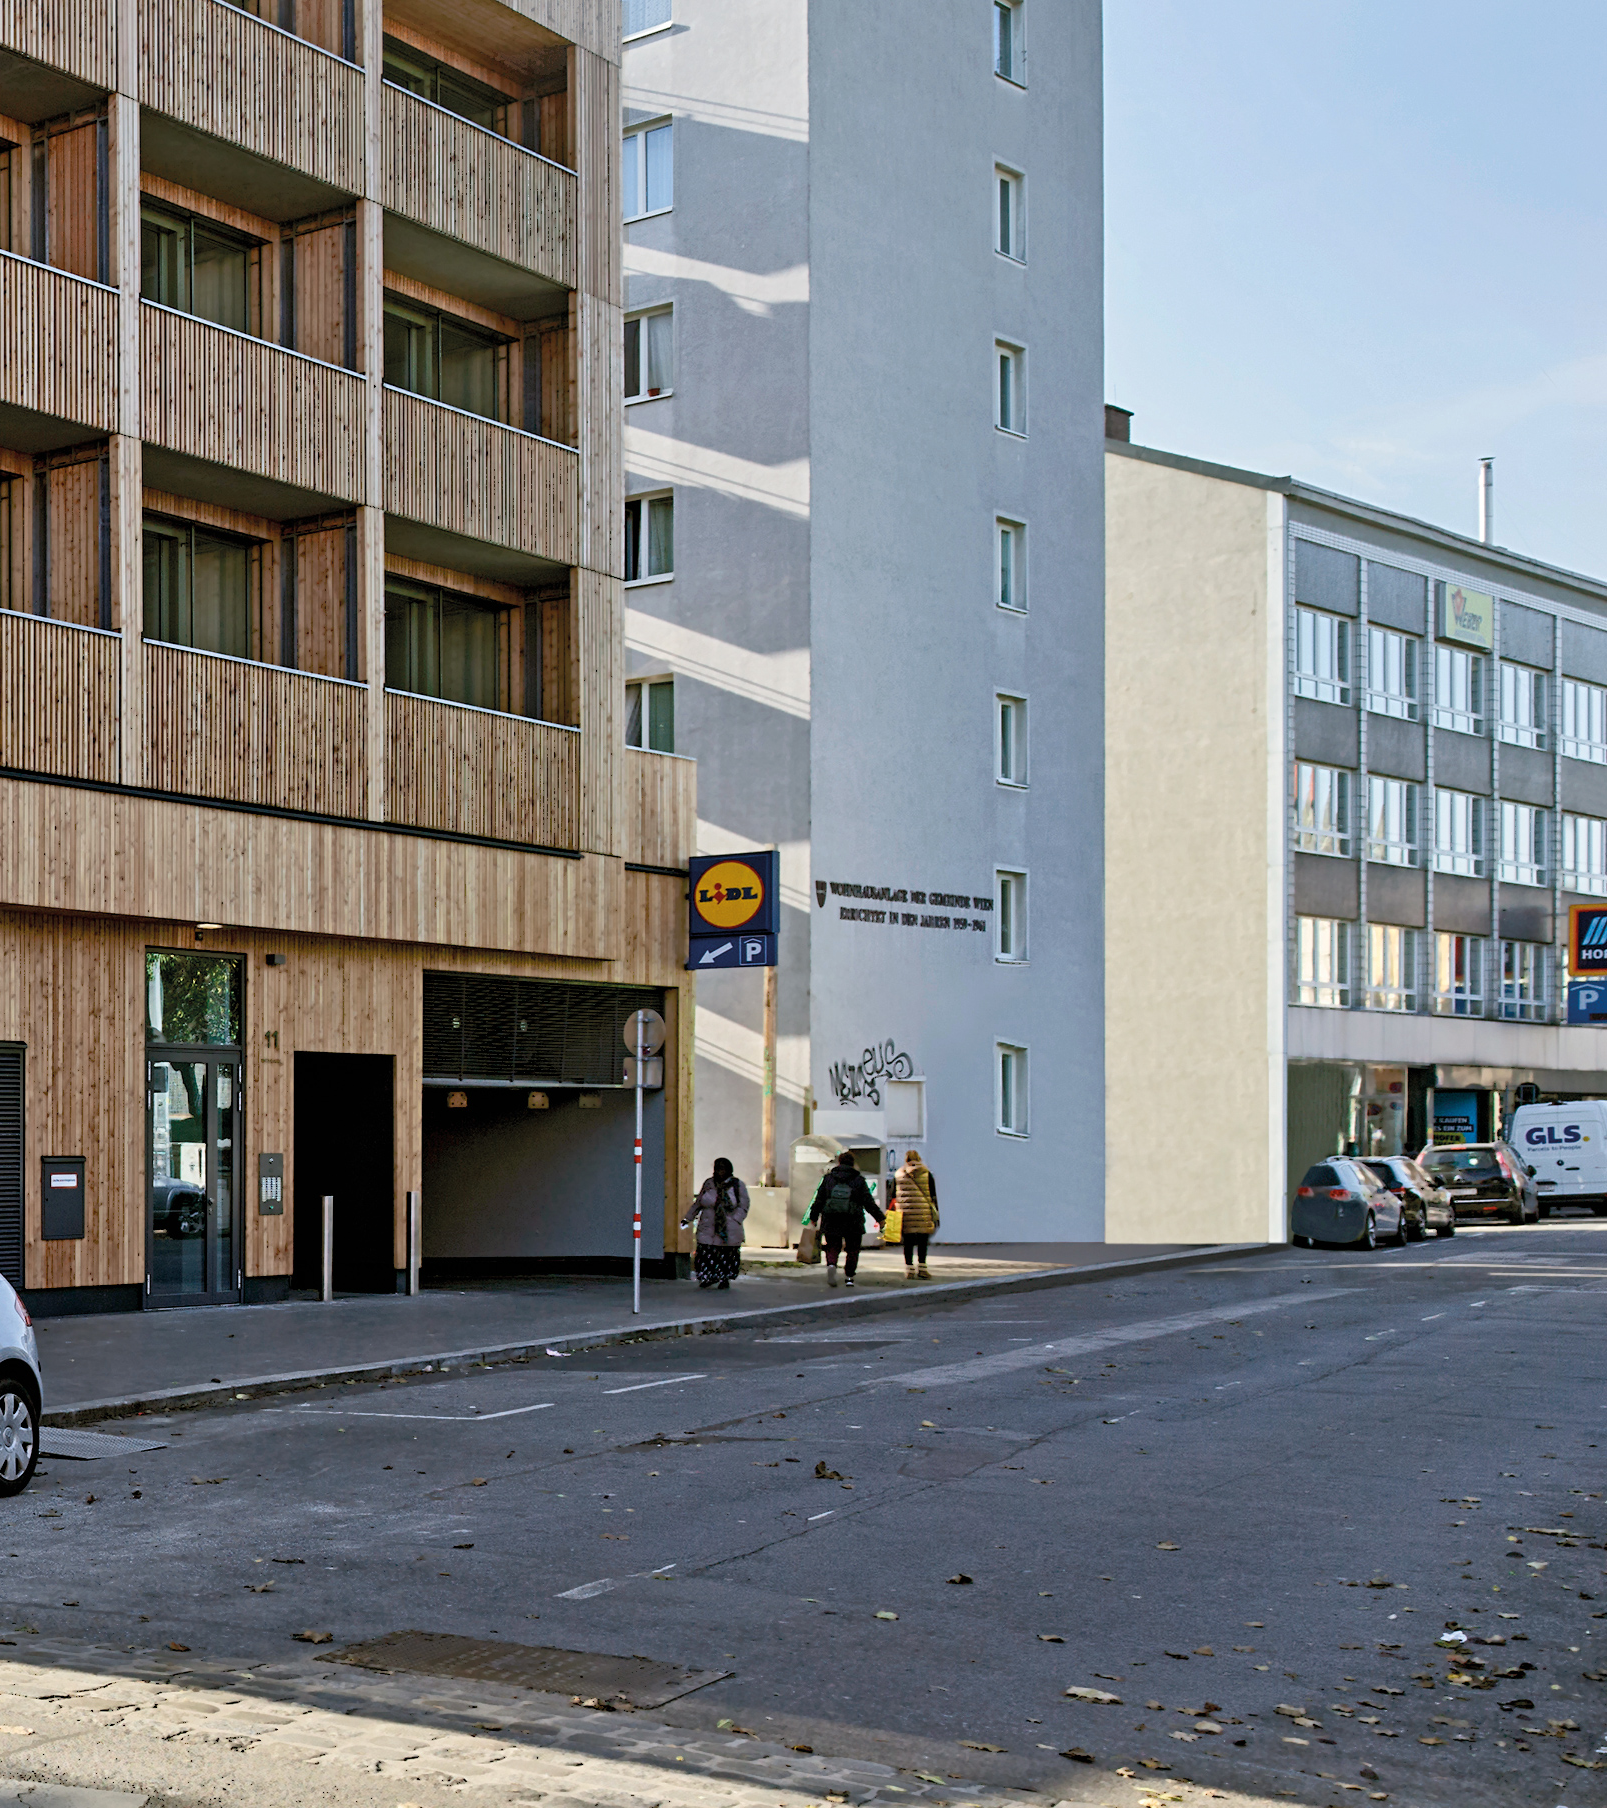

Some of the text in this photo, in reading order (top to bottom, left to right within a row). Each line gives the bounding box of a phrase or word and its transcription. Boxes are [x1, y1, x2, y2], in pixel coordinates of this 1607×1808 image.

[699, 883, 758, 904] LIDL
[929, 892, 971, 909] GEMEINDE
[973, 896, 994, 911] WIEN
[889, 911, 899, 925] IN
[746, 942, 762, 961] P
[1581, 949, 1607, 960] HO
[265, 1030, 279, 1049] 11
